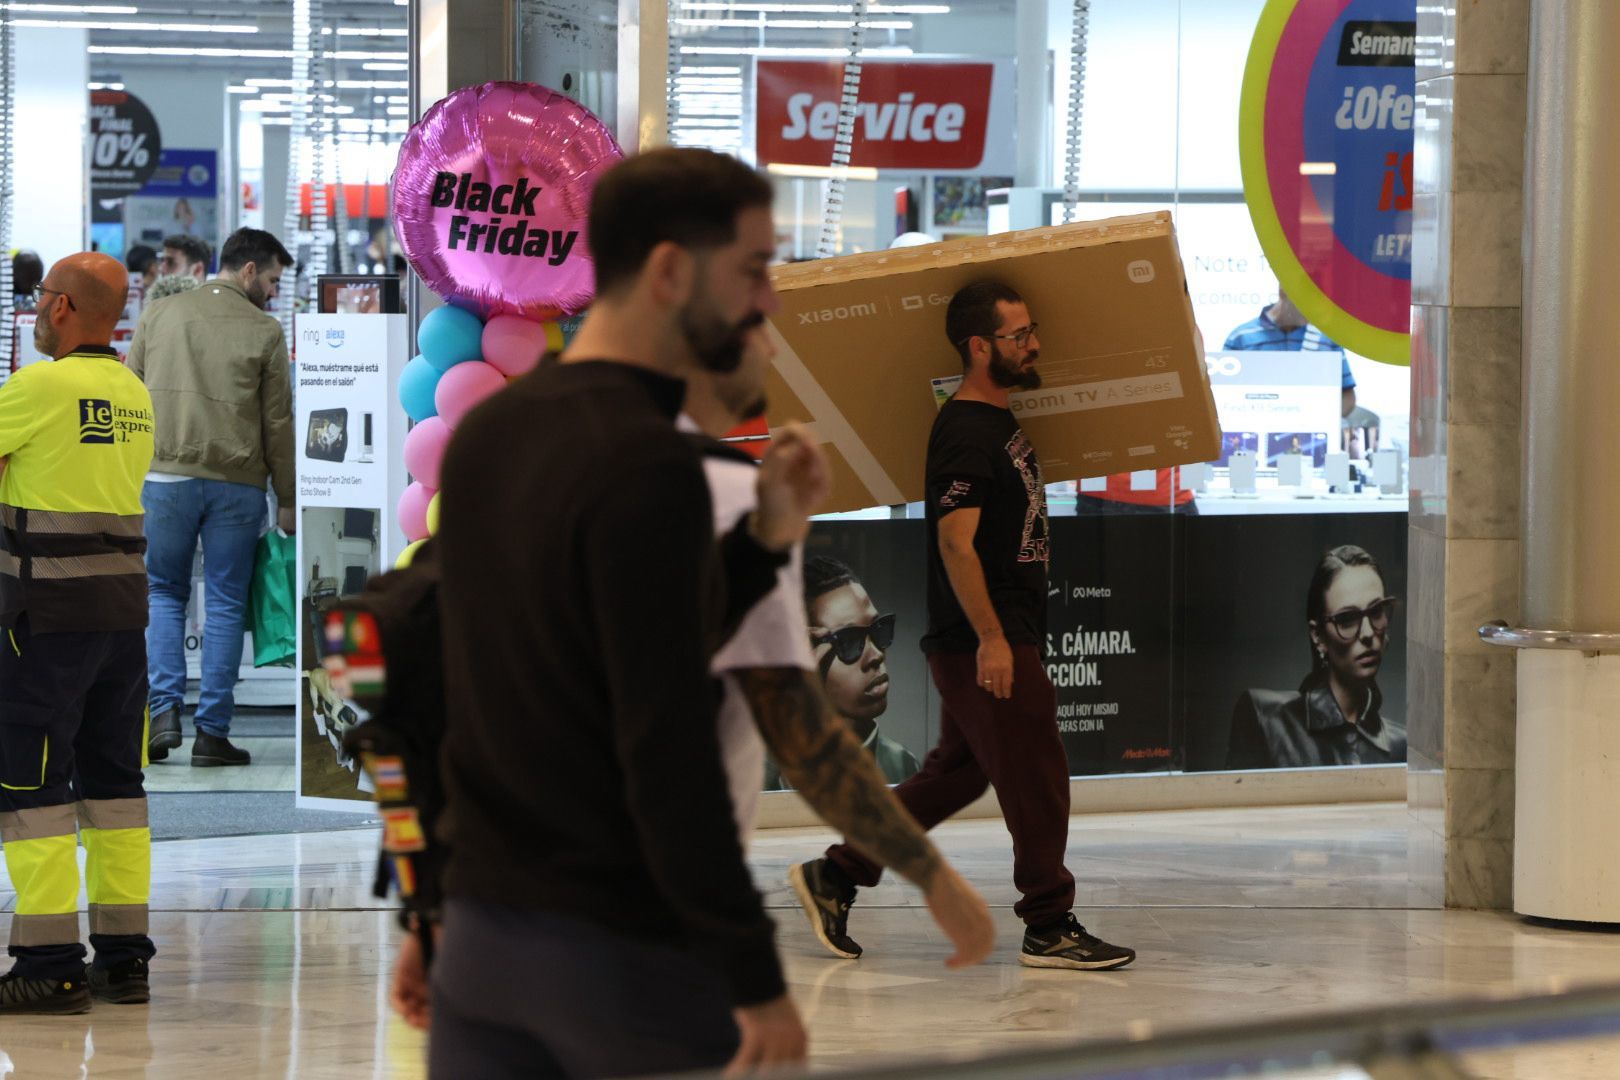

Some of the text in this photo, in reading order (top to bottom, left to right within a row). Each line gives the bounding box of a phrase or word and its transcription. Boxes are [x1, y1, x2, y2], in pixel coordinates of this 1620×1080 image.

[1350, 31, 1416, 56] Seman
[781, 93, 966, 142] Service
[1335, 85, 1414, 130] ¿Ofe
[1377, 152, 1414, 211] ¡S
[431, 171, 542, 217] Black
[447, 216, 579, 266] Friday
[1376, 234, 1411, 257] LET'
[1195, 255, 1248, 273] Note
[797, 293, 957, 325] xiaomi Go
[325, 328, 345, 340] alexa
[300, 376, 324, 387] pasando
[324, 378, 332, 386] en
[332, 376, 338, 386] el
[1011, 393, 1065, 411] aomi
[1074, 390, 1098, 404] TV
[1124, 382, 1171, 397] Series
[85, 400, 111, 424] ie
[113, 405, 152, 420] insul
[114, 420, 152, 433] expre
[1086, 587, 1112, 598] Meta
[1062, 625, 1136, 657] CÁMARA.
[1046, 656, 1102, 687] CCIÓN.
[1057, 701, 1119, 718] AQUÍ HOY MISMO
[1078, 719, 1096, 731] CON
